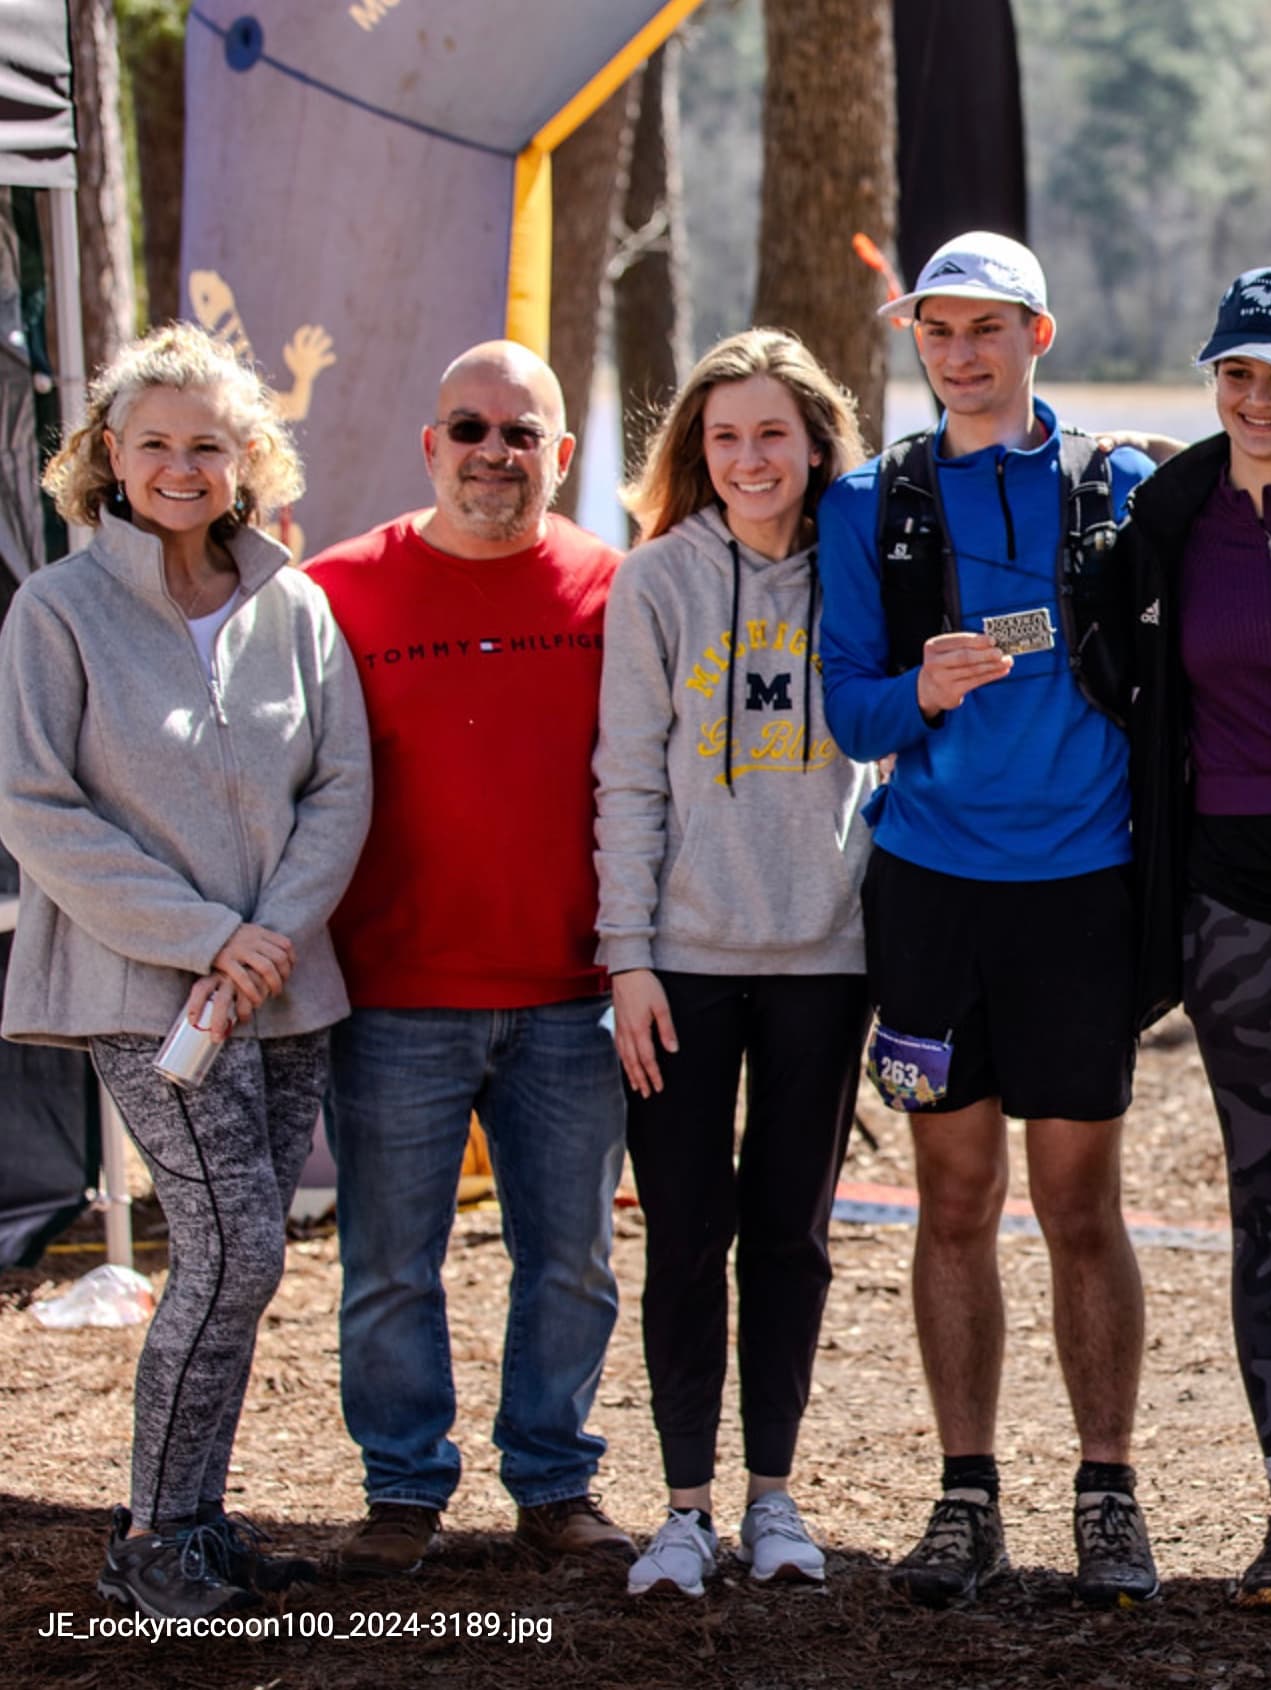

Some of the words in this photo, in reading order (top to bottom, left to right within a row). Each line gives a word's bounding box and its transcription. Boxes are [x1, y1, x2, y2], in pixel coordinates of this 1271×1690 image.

[365, 640, 471, 669] TOMMY
[510, 634, 603, 651] HILFIGE
[685, 619, 823, 699] MICHIG
[744, 672, 793, 711] M
[881, 1056, 919, 1088] 263
